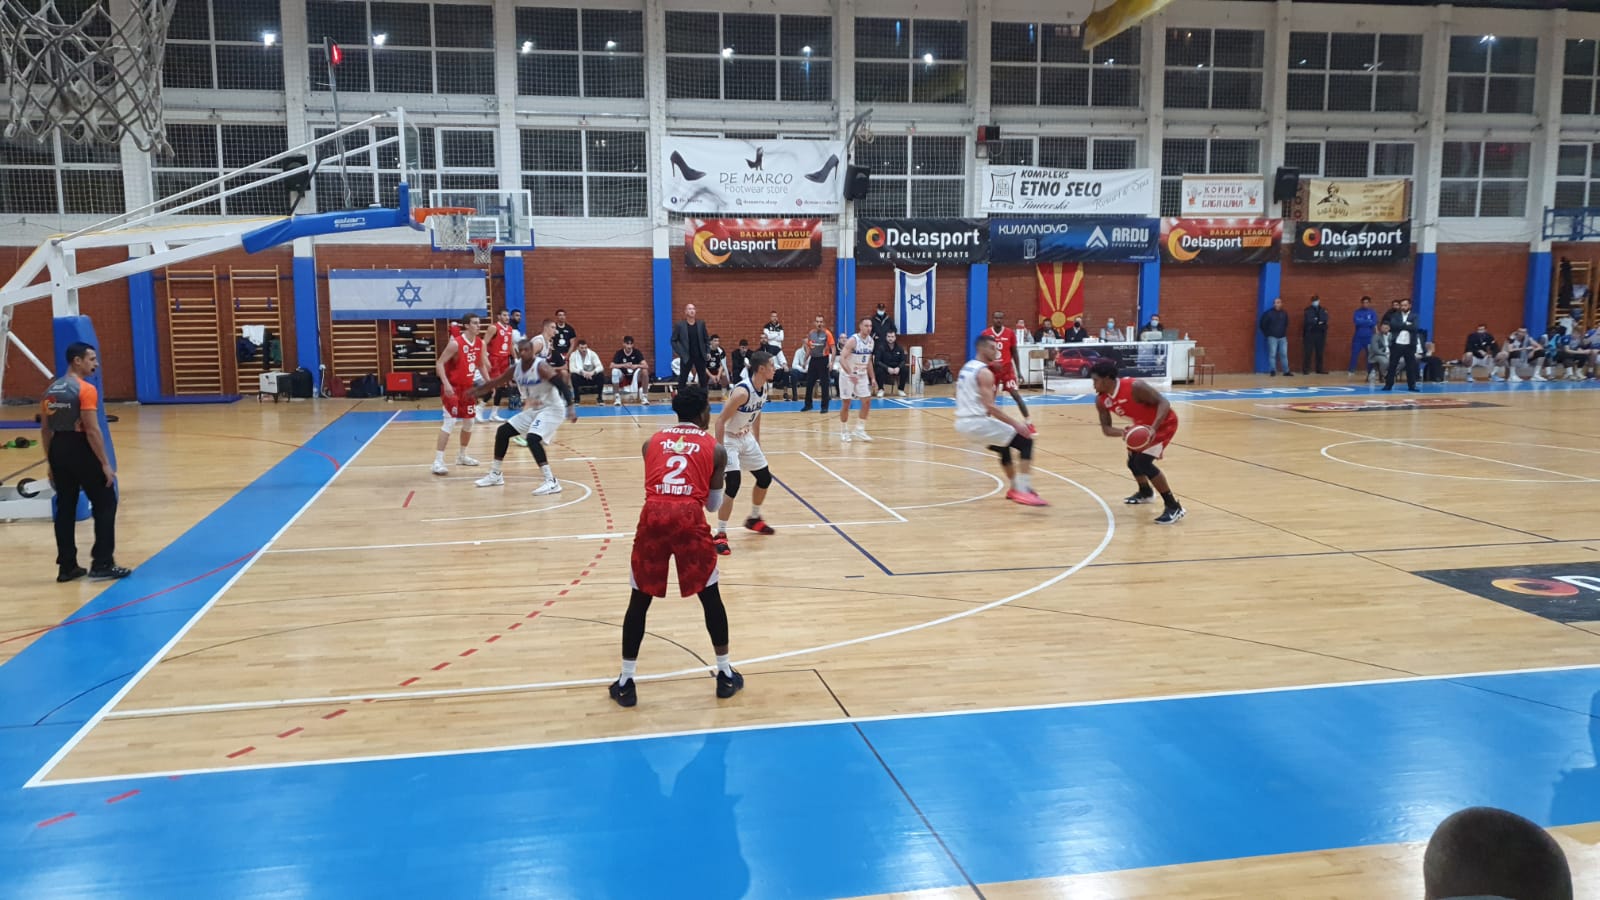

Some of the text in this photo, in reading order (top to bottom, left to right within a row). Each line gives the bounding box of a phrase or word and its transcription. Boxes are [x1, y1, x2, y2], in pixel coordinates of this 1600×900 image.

[719, 172, 793, 185] DE MARCO
[1020, 169, 1070, 179] KOMPLEKS
[724, 184, 789, 194] Footwear store
[1019, 180, 1103, 198] ETNO SELO
[998, 223, 1069, 235] KUMANOVO
[1111, 227, 1149, 243] ARDU
[709, 237, 777, 253] Delasport
[886, 228, 980, 250] Delasport
[1182, 235, 1242, 250] Delasport
[1321, 228, 1402, 248] Delasport
[467, 353, 477, 361] 55
[662, 455, 688, 485] 2
